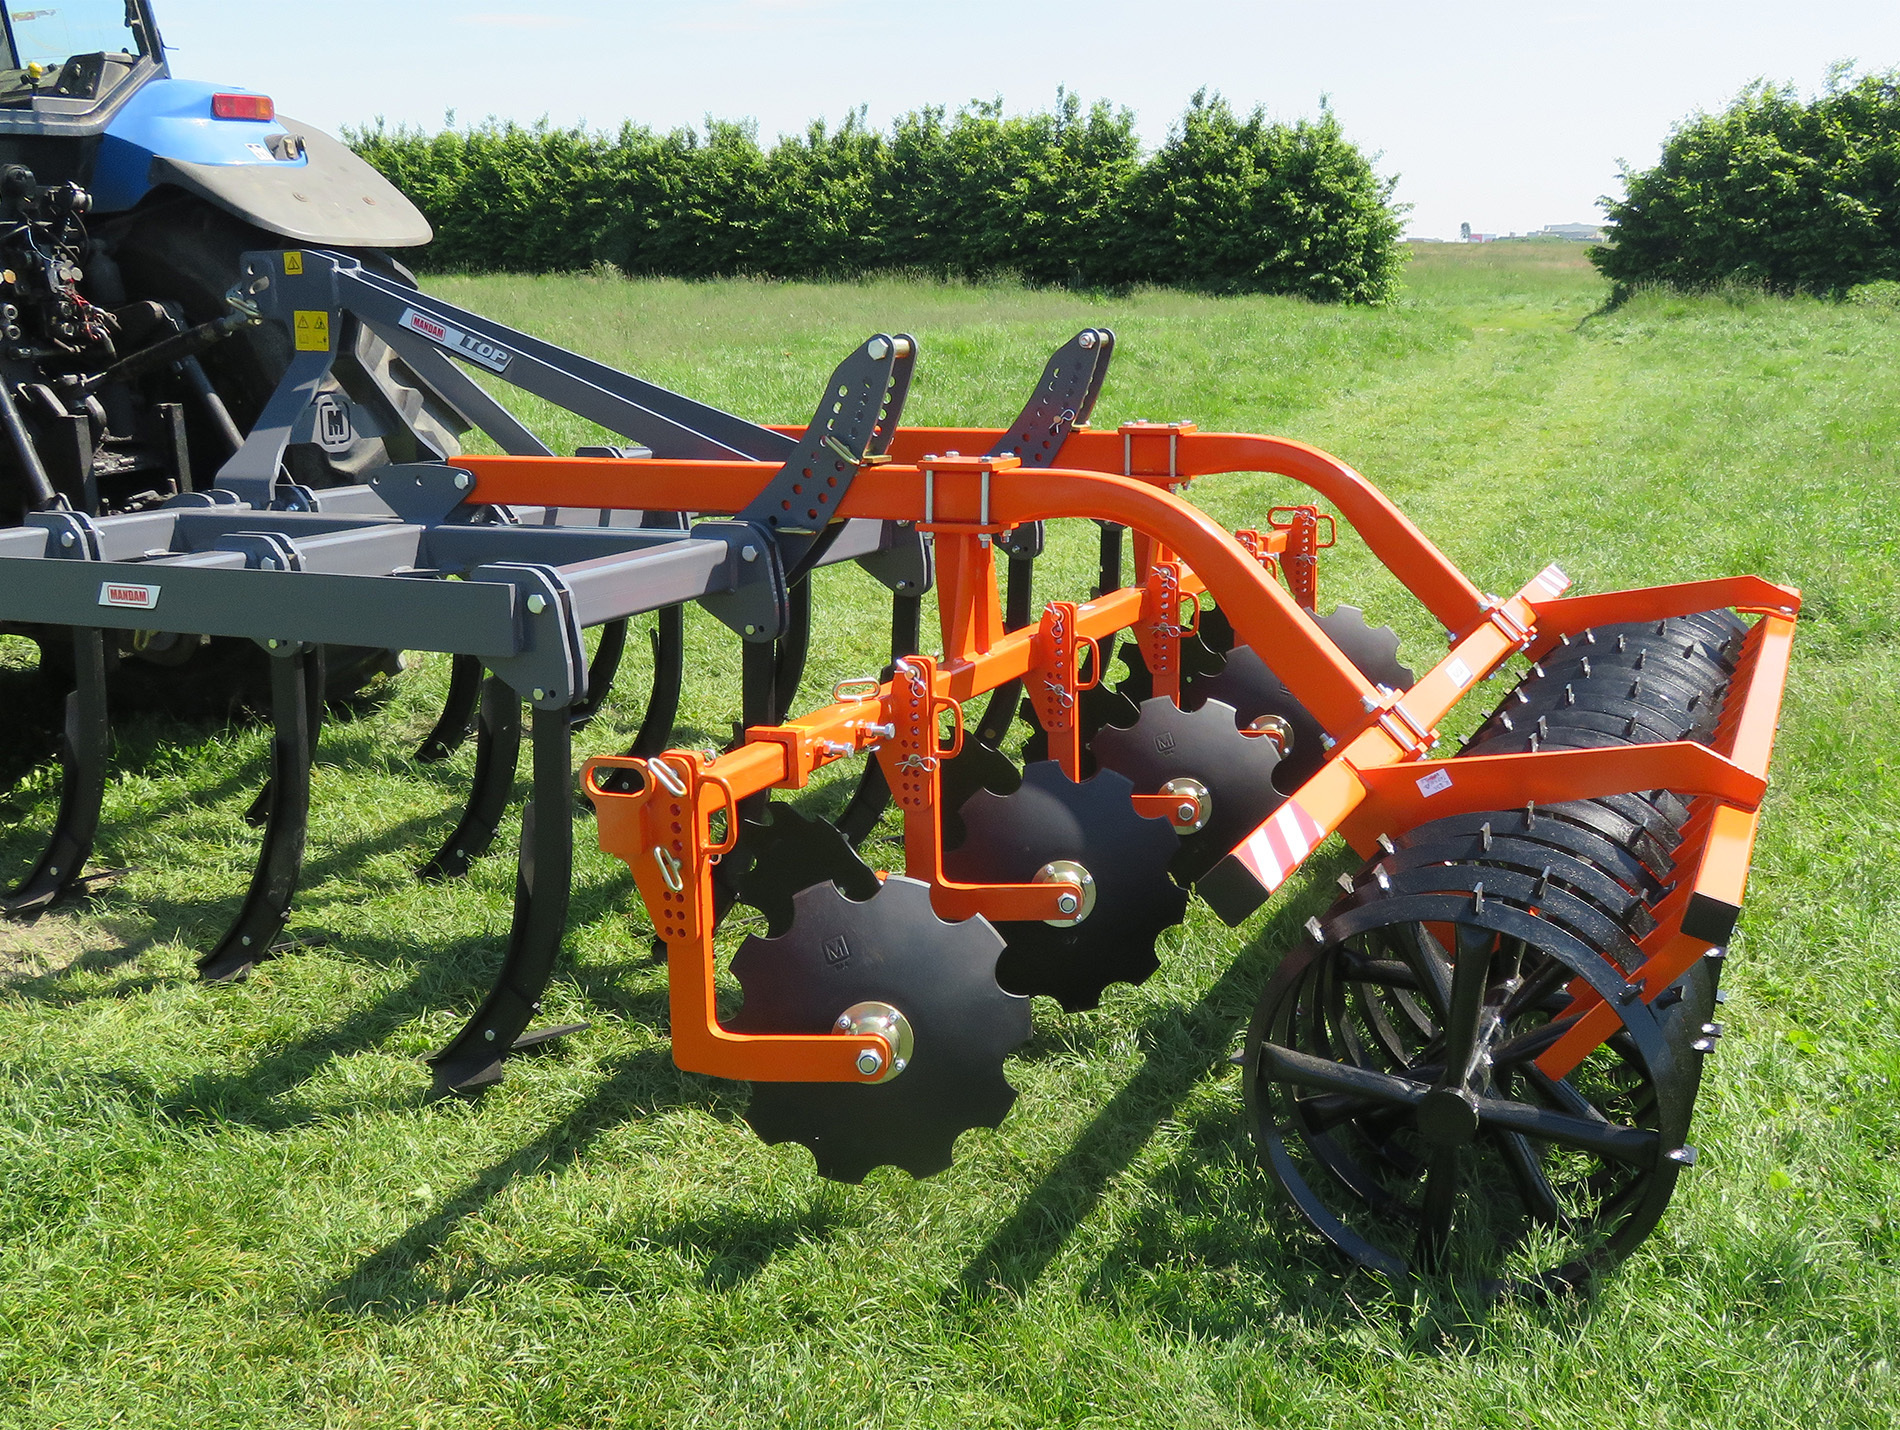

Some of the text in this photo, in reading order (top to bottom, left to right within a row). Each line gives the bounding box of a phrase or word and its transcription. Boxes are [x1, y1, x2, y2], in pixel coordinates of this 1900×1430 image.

[413, 317, 444, 338] MANDAM
[465, 336, 508, 361] TOP
[109, 588, 147, 602] MANDAM
